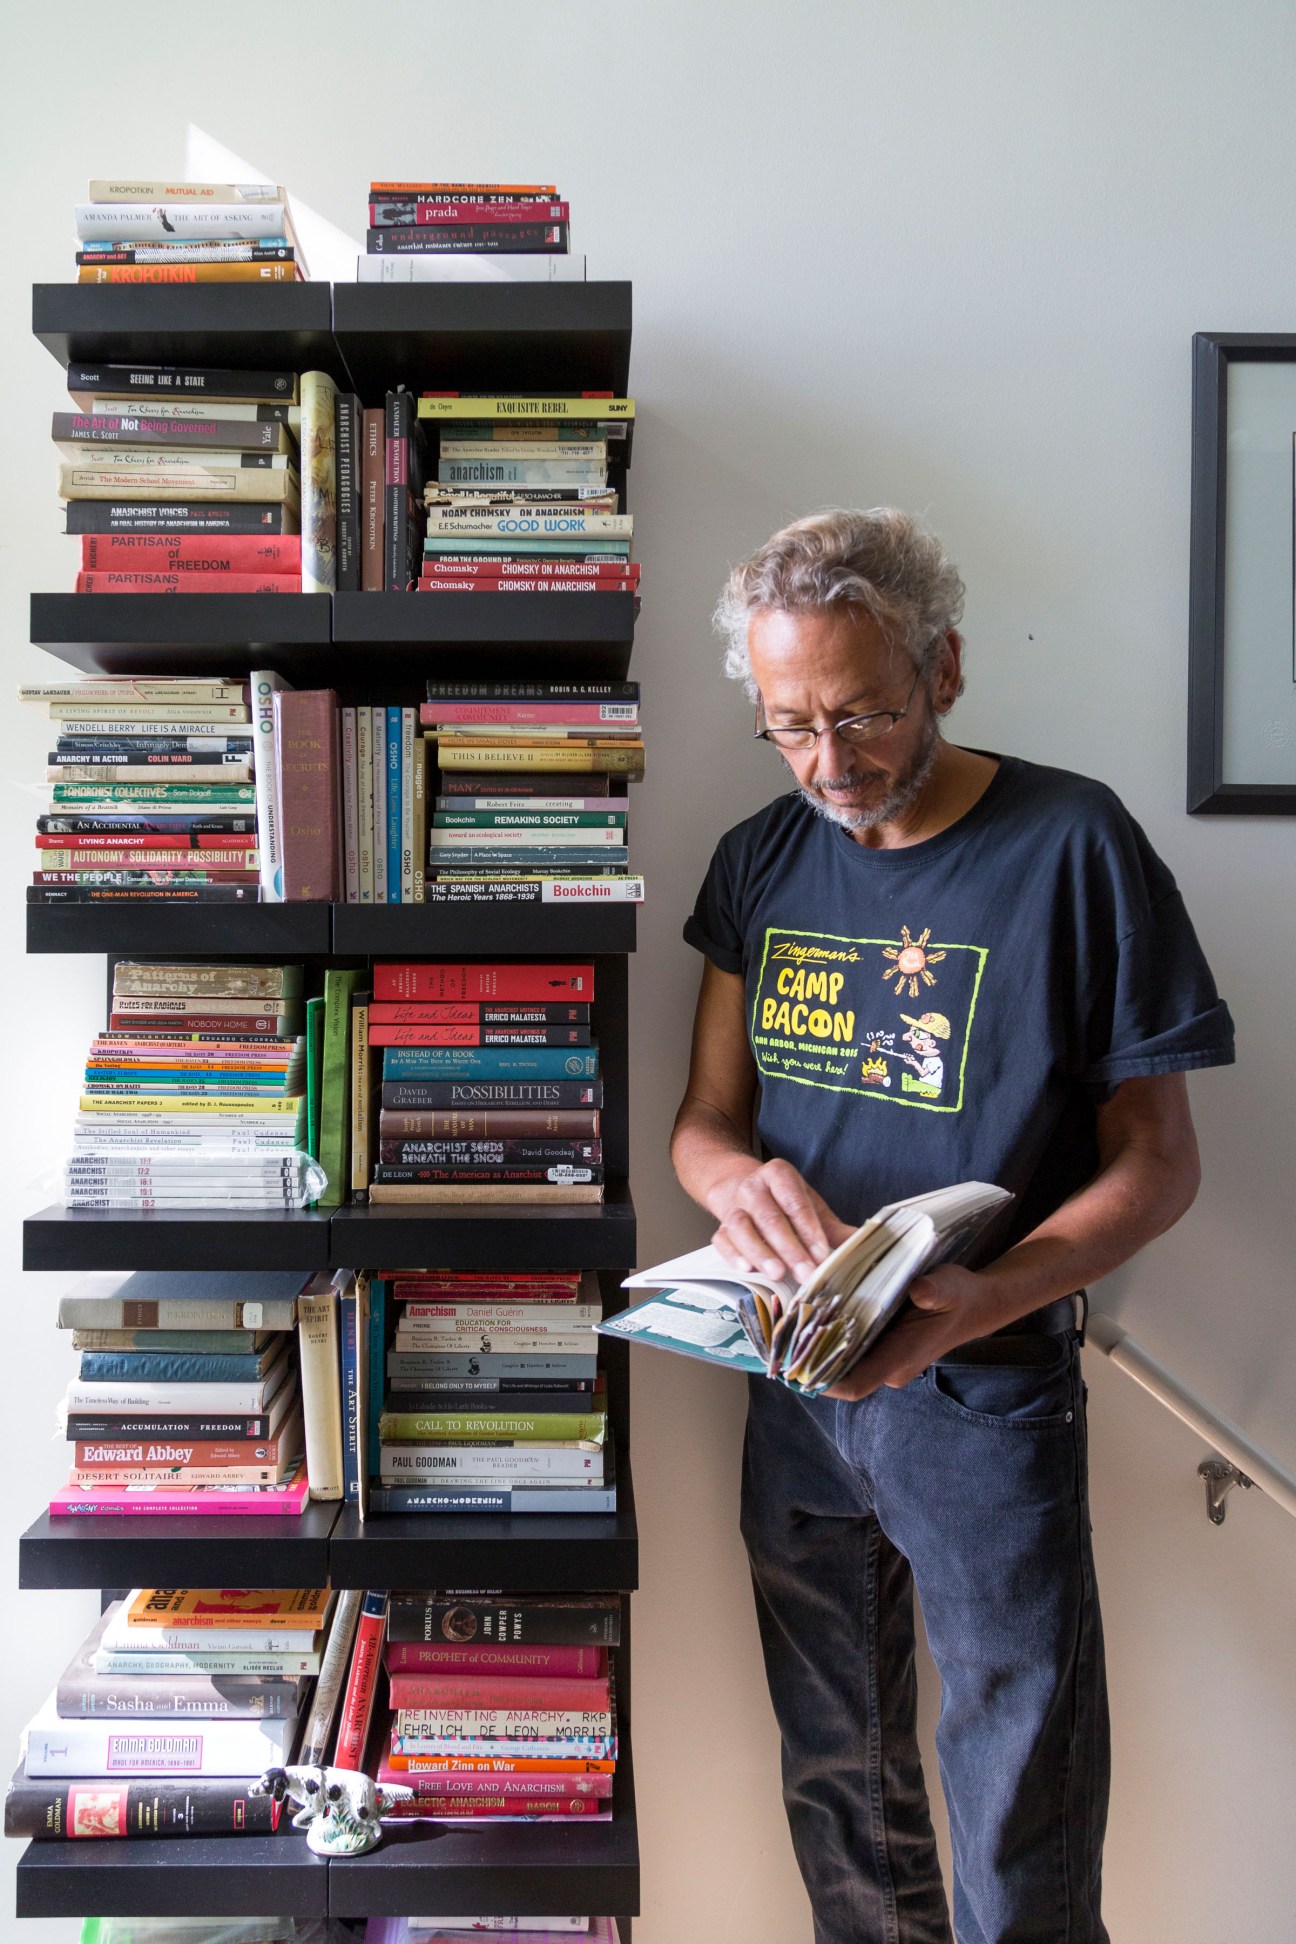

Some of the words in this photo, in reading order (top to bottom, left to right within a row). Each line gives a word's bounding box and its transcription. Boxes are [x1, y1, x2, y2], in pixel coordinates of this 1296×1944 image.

[110, 186, 153, 194] KROPOTKIN
[200, 188, 213, 196] AID
[417, 195, 483, 203] HARDCORE
[224, 214, 252, 222] ASKING
[426, 207, 458, 220] prada
[111, 265, 196, 283] KROPOTKIN
[130, 374, 154, 384] SEEING
[158, 376, 171, 385] LIKE
[176, 376, 180, 385] A
[185, 377, 204, 386] STATE
[497, 402, 539, 413] EXQUISITE
[542, 403, 568, 413] REBEL
[72, 416, 88, 428] The
[92, 418, 106, 428] Art
[108, 419, 119, 429] of
[121, 419, 138, 430] Not
[141, 420, 167, 433] Being
[171, 421, 217, 434] Governed
[262, 426, 271, 443] Yale
[450, 464, 504, 481] anarchism
[111, 508, 157, 516] ANARCHIST
[159, 508, 188, 516] VOICES
[470, 509, 510, 517] CHOMSKY
[498, 520, 539, 532] GOOD
[545, 519, 586, 531] WORK
[112, 537, 181, 546] PARTISANS
[168, 550, 179, 559] of
[169, 561, 230, 570] FREEDOM
[434, 564, 478, 573] Chomsky
[502, 565, 538, 574] CHOMSKY
[542, 566, 552, 574] ON
[555, 566, 599, 575] ANARCHISM
[108, 574, 179, 583] PARTISANS
[430, 581, 475, 589] Chomsky
[498, 582, 535, 591] CHOMSKY
[538, 582, 548, 591] ON
[551, 582, 595, 591] ANARCHISM
[257, 681, 274, 734] OSHO
[66, 724, 106, 732] WENDELL
[108, 724, 134, 732] BERRY
[142, 724, 157, 732] LIFE
[160, 724, 168, 732] IS
[179, 725, 215, 733] MIRACLE
[445, 816, 475, 824] Bookchin
[495, 816, 541, 824] REMAKING
[543, 816, 579, 824] SOCIETY
[268, 805, 276, 863] UNDERSTANDING
[74, 852, 123, 862] AUTONOMY
[129, 852, 182, 862] SOLIDARITY
[188, 851, 243, 862] POSSIBILITY
[82, 874, 122, 882] PEOPLE
[431, 884, 446, 893] THE
[451, 884, 483, 893] SPANISH
[488, 884, 539, 892] ANARCHISTS
[553, 884, 610, 896] Bookchin
[772, 942, 864, 963] Zingerman's
[777, 968, 844, 1005] CAMP
[485, 1013, 508, 1021] ERRICO
[510, 1013, 546, 1021] MALATESTA
[762, 998, 855, 1042] BACON
[188, 1021, 221, 1029] NOBODY
[485, 1035, 508, 1043] ERRICO
[511, 1035, 547, 1043] MALATESTA
[755, 1036, 767, 1045] ANN
[769, 1038, 796, 1050] ARBOR,
[799, 1042, 838, 1055] MICHIGAN
[840, 1048, 858, 1057] 2015
[762, 1052, 780, 1063] Wish
[782, 1056, 800, 1070] you
[803, 1061, 822, 1071] were
[825, 1061, 848, 1075] here!
[452, 1086, 559, 1099] POSSIBILITIES
[402, 1154, 446, 1163] BENEATH
[451, 1154, 470, 1163] THE
[473, 1154, 503, 1162] SNOW
[433, 1171, 446, 1179] The
[452, 1171, 490, 1179] American
[504, 1171, 541, 1179] Anarchist
[410, 1306, 456, 1316] Anarchism
[467, 1308, 492, 1316] Daniel
[496, 1307, 523, 1316] Guérin
[416, 1421, 442, 1430] CALL
[447, 1421, 460, 1430] TO
[466, 1421, 534, 1430] REVOLUTION
[84, 1447, 142, 1461] Edward
[146, 1446, 193, 1463] Abbey
[392, 1457, 413, 1467] PAUL
[416, 1457, 456, 1467] GOODMAN
[124, 1472, 182, 1480] SOLITAIRE
[499, 1610, 507, 1641] COWPER
[420, 1652, 466, 1662] PROPHET
[481, 1654, 549, 1664] COMMUNITY
[107, 1695, 154, 1711] Sasha
[174, 1696, 228, 1711] Emma
[404, 1710, 497, 1721] REINVENTING
[506, 1713, 570, 1722] ANARCHY.
[582, 1713, 606, 1722] RKP
[404, 1725, 463, 1735] EHRLICH
[480, 1725, 495, 1735] DE
[505, 1726, 538, 1735] LEON
[556, 1727, 606, 1736] MORRIS
[114, 1739, 146, 1752] EMMA
[149, 1739, 198, 1752] GOLDMAN
[408, 1760, 448, 1770] Howard
[451, 1760, 476, 1771] Zinn
[478, 1763, 490, 1771] on
[493, 1761, 515, 1771] War
